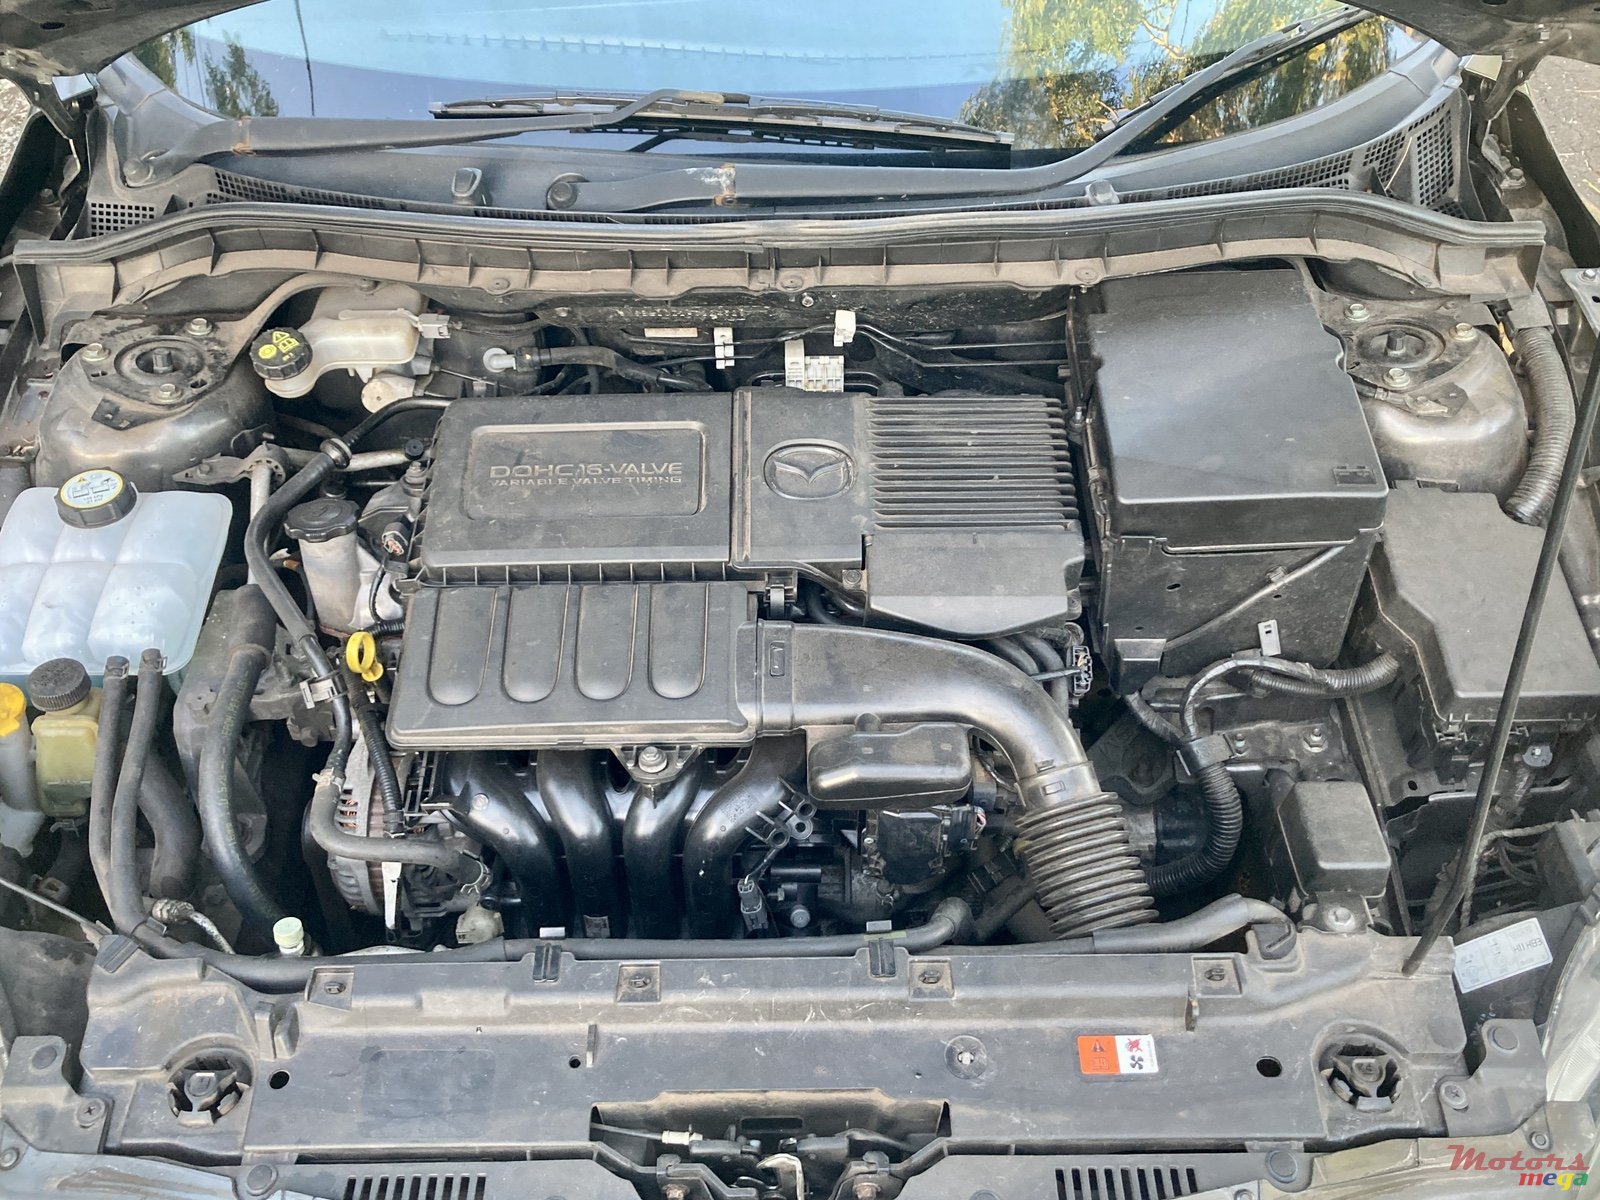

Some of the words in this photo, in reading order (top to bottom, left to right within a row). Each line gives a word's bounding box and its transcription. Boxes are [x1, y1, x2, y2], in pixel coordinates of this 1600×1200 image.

[489, 464, 573, 478] DOHC
[579, 462, 682, 477] 16-VALVE
[573, 477, 621, 485] VALVE
[626, 476, 682, 484] TIMING
